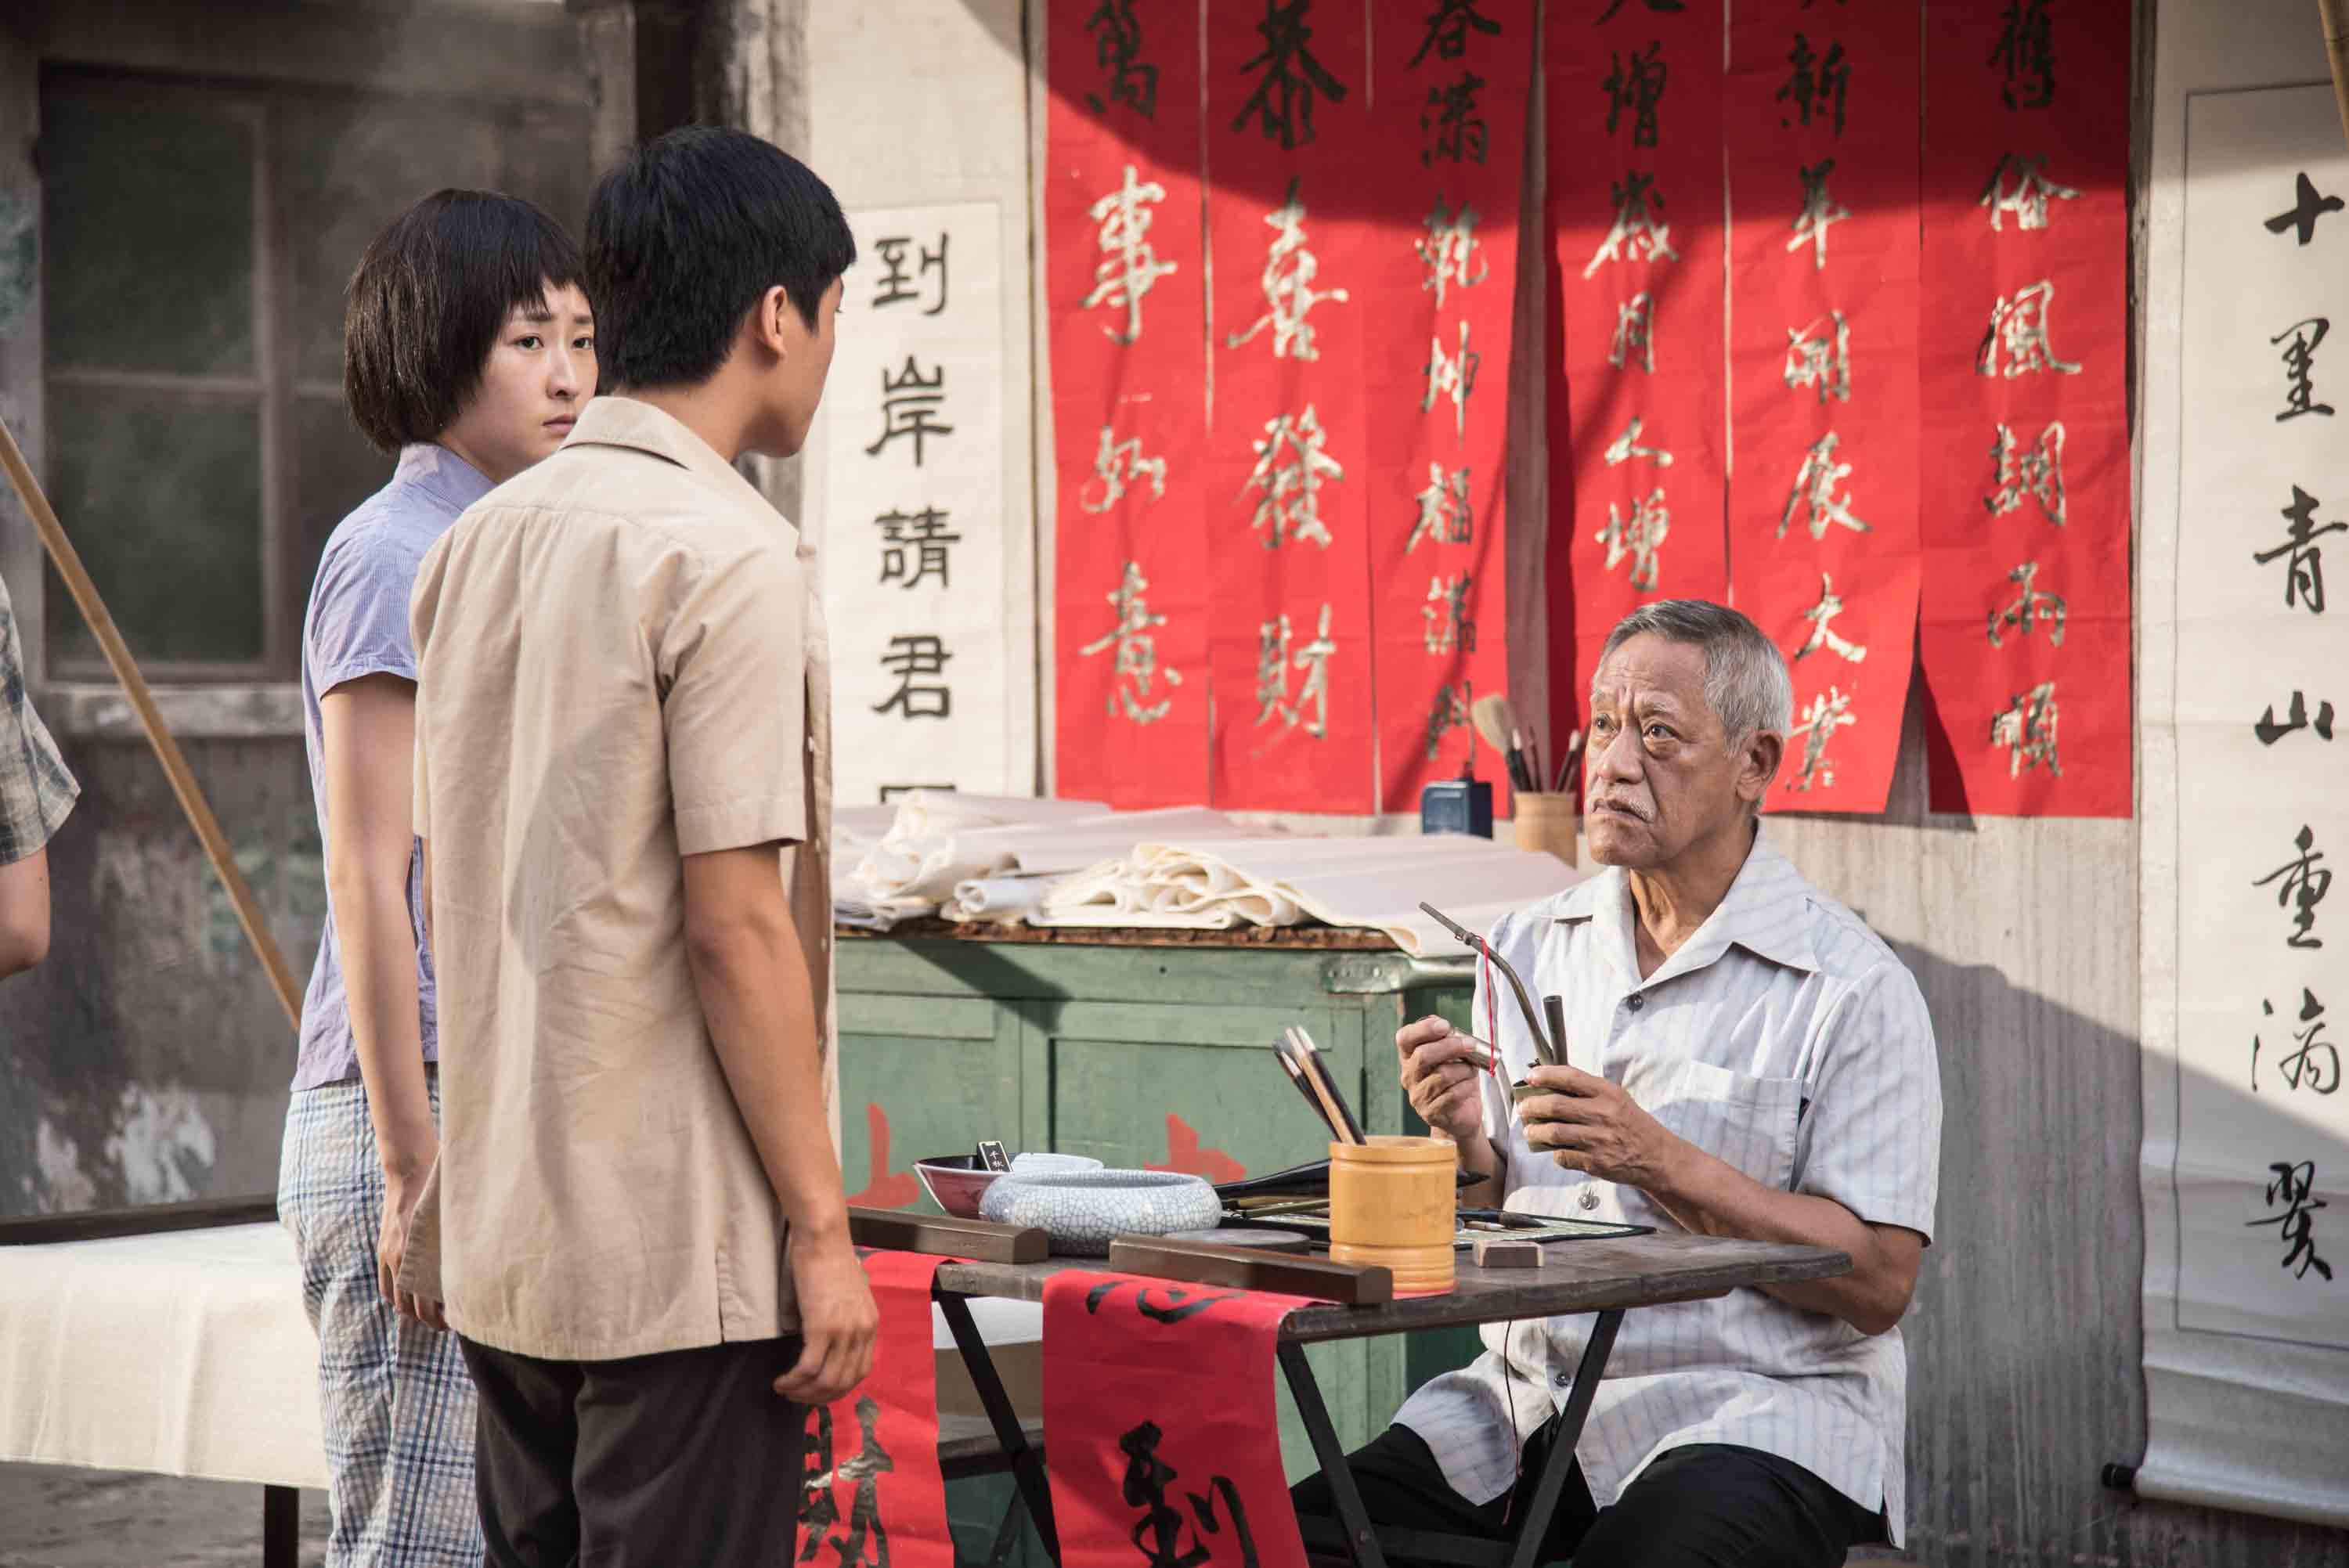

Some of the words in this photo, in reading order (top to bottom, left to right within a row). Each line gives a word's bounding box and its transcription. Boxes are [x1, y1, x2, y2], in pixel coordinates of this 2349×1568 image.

[865, 230, 963, 803] 到岸請君
[1078, 0, 1185, 726] 萬事如意
[1225, 0, 1351, 766] 恭喜發財
[1580, 0, 1685, 593] 增歲月人增
[2245, 171, 2348, 1282] 十里青山重滴翠
[989, 1150, 1005, 1172] 千秋
